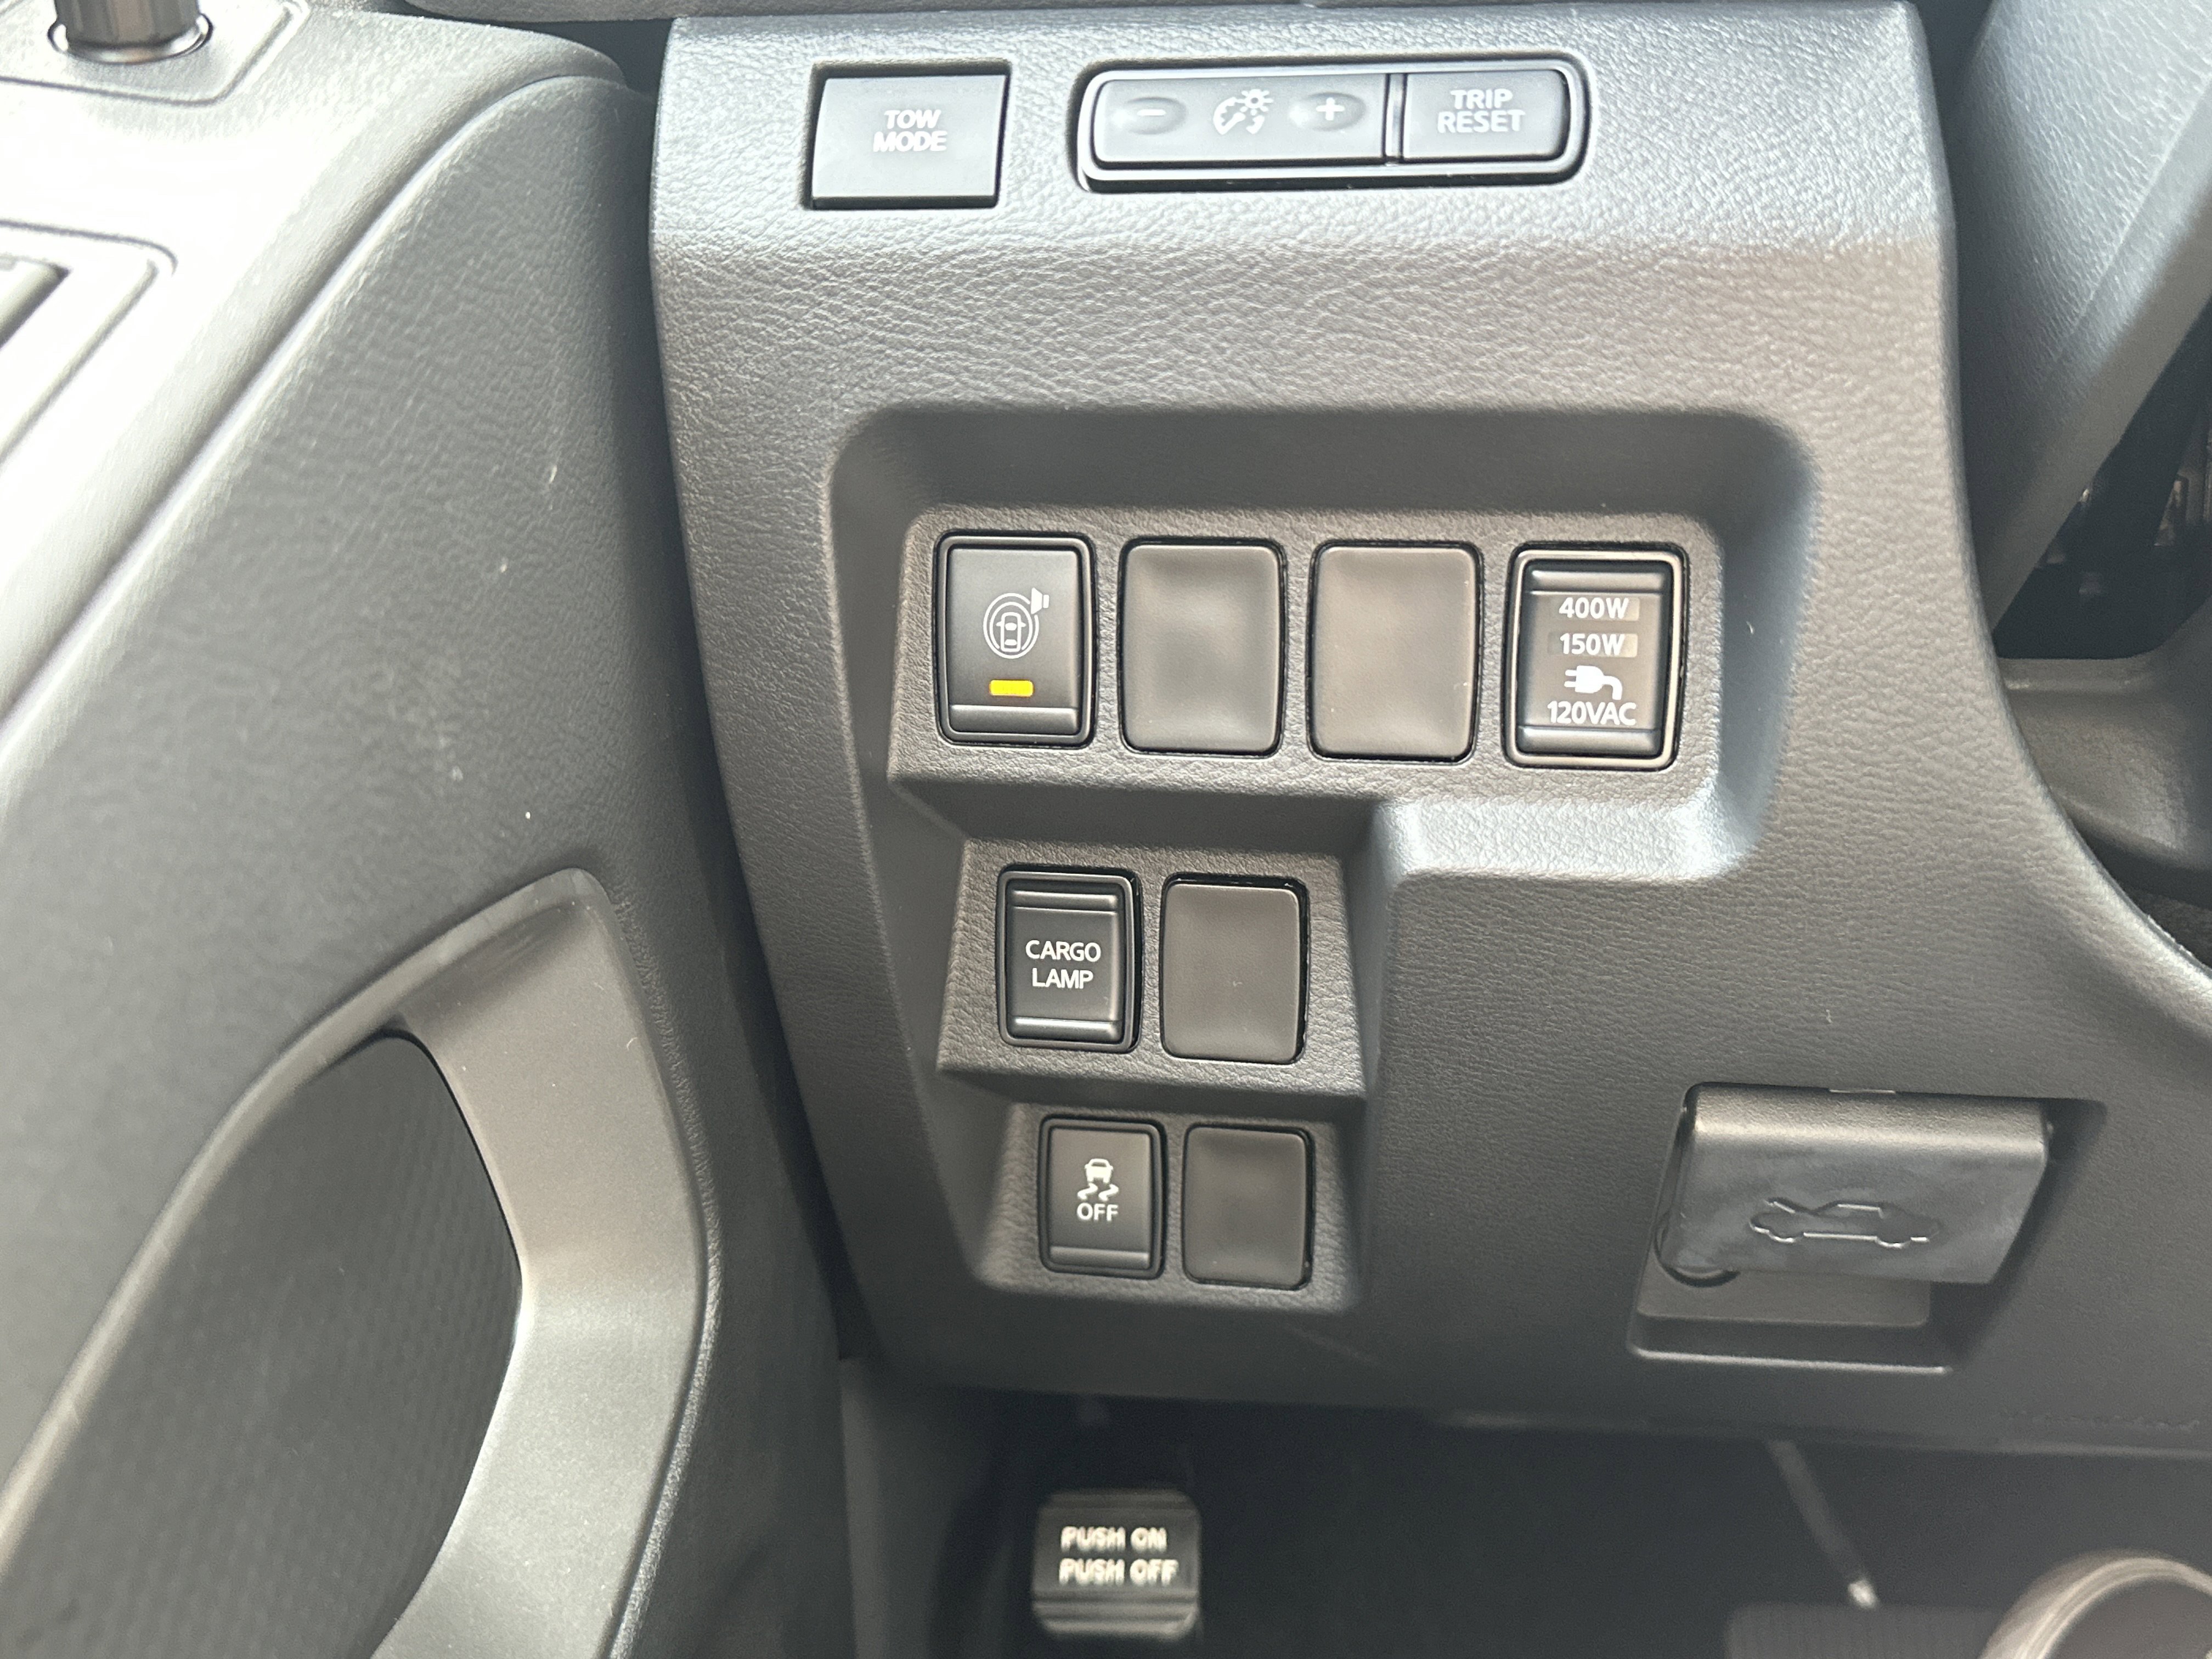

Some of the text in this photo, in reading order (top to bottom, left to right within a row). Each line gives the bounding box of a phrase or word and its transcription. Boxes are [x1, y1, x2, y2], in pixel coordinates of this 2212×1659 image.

[1450, 88, 1513, 109] TRIP
[884, 109, 941, 129] TOW
[1437, 109, 1526, 133] RESET
[873, 131, 948, 153] MODE
[1559, 597, 1629, 619] 400W
[1560, 633, 1625, 656] 150W
[1547, 701, 1637, 725] 120VAC
[1025, 940, 1101, 962] CARGO
[1032, 967, 1094, 989] LAMP
[1077, 1202, 1119, 1222] OFF
[1060, 1526, 1167, 1553] PUSH ON
[1059, 1558, 1179, 1586] PUSH OFF
